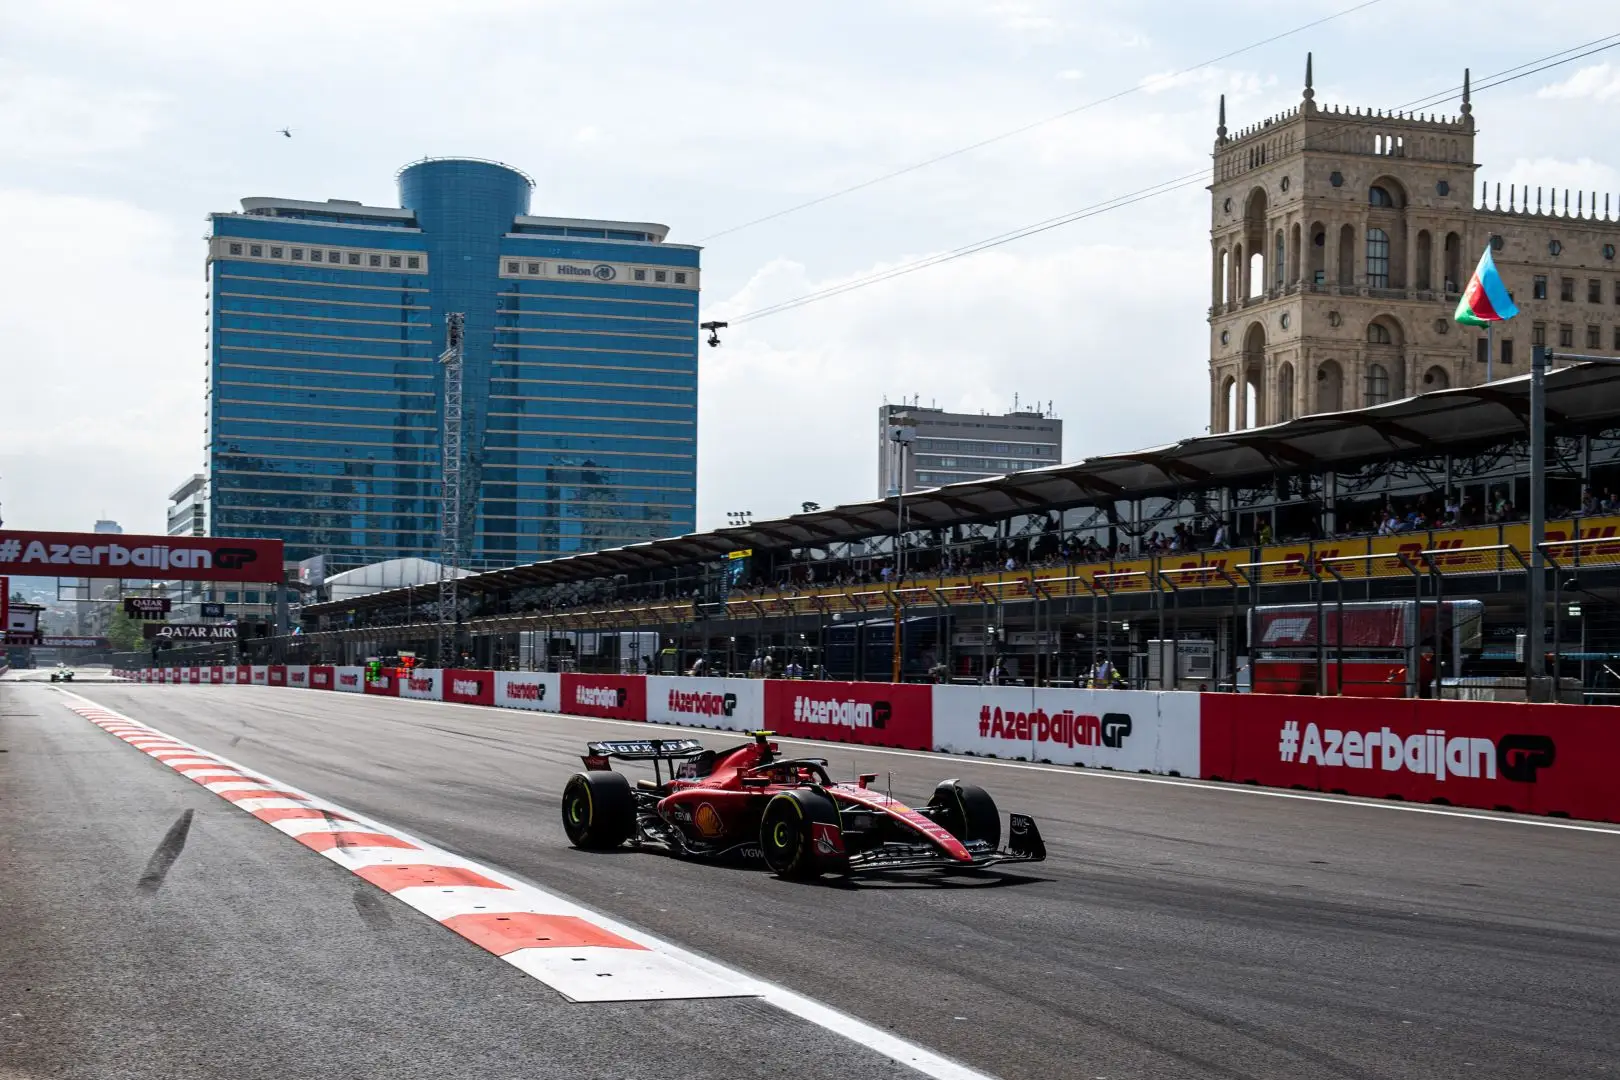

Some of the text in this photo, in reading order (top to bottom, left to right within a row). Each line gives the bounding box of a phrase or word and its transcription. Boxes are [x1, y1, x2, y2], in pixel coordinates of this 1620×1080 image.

[557, 264, 591, 276] Hilton
[160, 626, 207, 639] QATAR
[679, 763, 697, 776] 55
[741, 847, 765, 859] VGW
